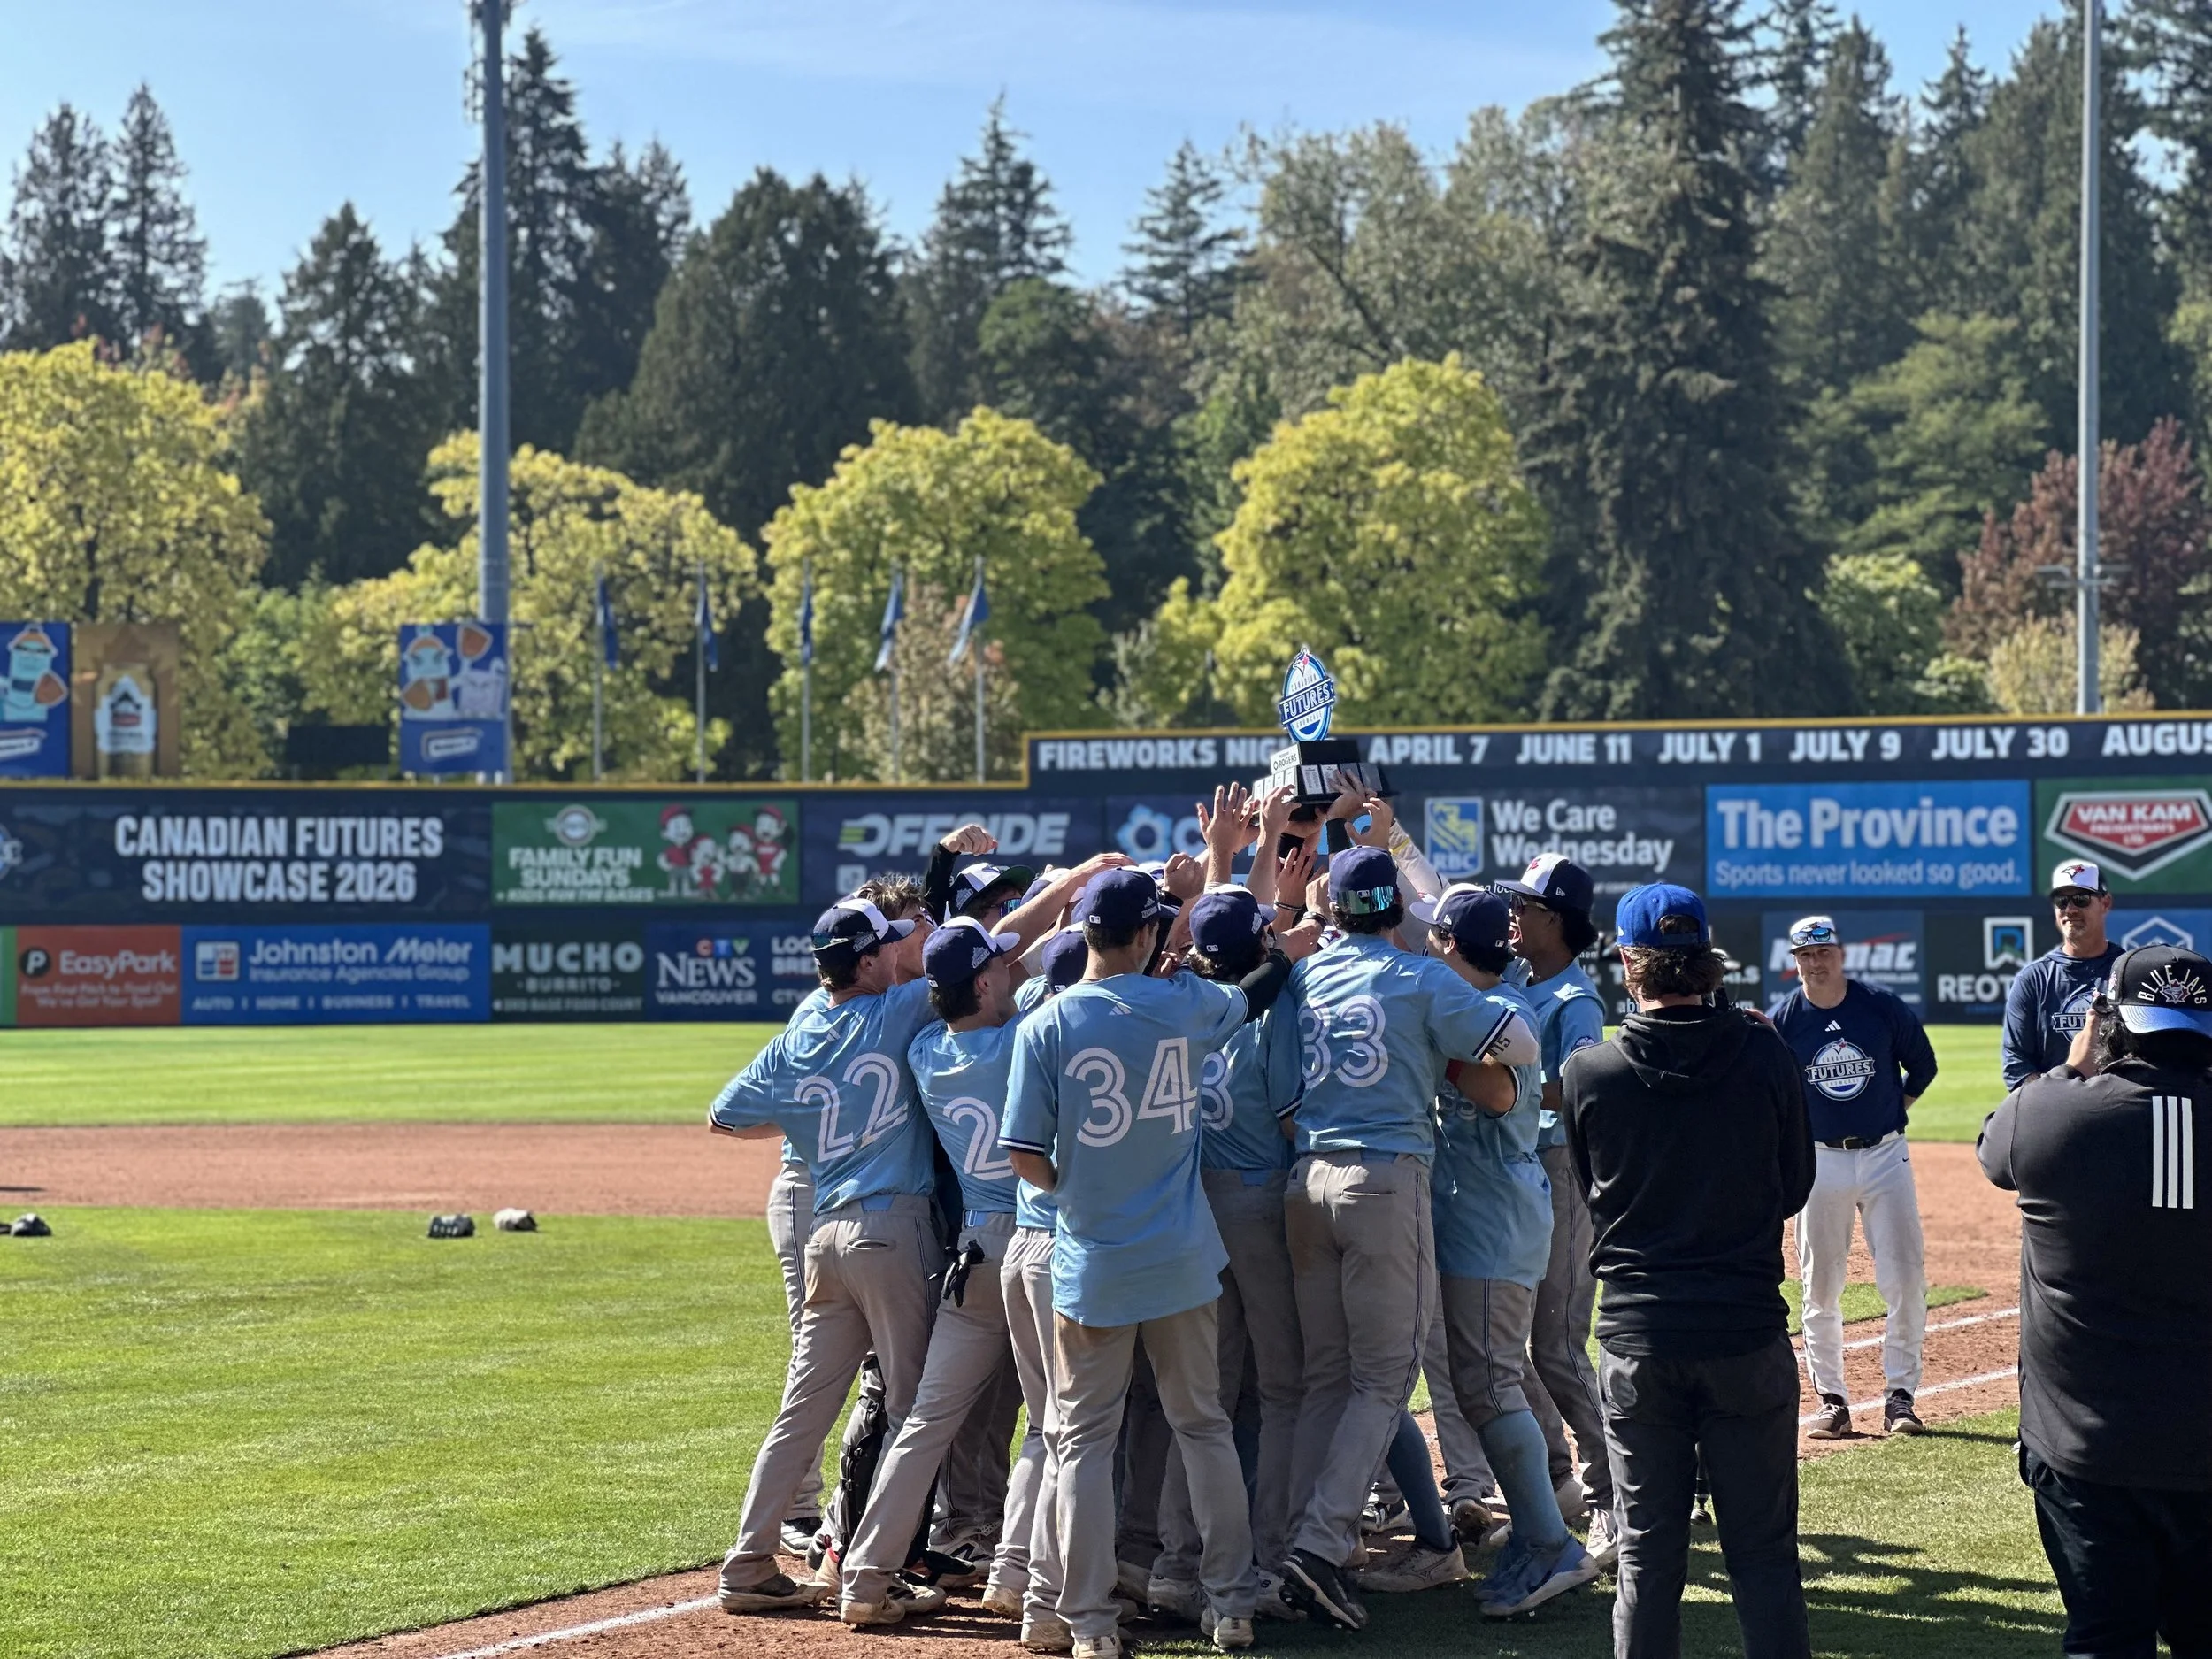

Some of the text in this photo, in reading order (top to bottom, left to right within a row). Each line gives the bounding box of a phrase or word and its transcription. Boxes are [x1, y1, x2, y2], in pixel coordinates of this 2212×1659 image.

[1283, 683, 1330, 720] FUTURES
[1038, 737, 1288, 770] FIREWORKS NIG
[1368, 735, 1490, 764] APRIL 7
[1516, 733, 1631, 764] JUNE 11
[1658, 733, 1761, 763] JULY 1
[1789, 731, 1901, 762] JULY 9
[1932, 727, 2069, 760] JULY 30
[1279, 753, 1297, 767] ROGERS
[1491, 800, 1617, 833] We Care
[1717, 797, 2018, 849] The Province
[2077, 803, 2192, 823] VAN KAM
[115, 816, 443, 857] CANADIAN FUTURES
[509, 846, 642, 869] FAMILY FUN
[1431, 851, 1476, 872] RBC
[142, 860, 417, 902] SHOWCASE 2026
[521, 867, 631, 887] SUNDAYS
[1716, 858, 2021, 890] Sports never looked so good.
[248, 939, 378, 964] Johnston
[492, 941, 644, 973] MUCHO
[696, 939, 749, 956] CTV
[772, 936, 811, 955] LOC
[59, 949, 177, 979] EasyPark
[415, 964, 470, 983] Group
[655, 989, 757, 1005] VANCOUVER
[1938, 974, 2015, 1002] REOT
[2137, 964, 2208, 1004] BLUE JAYS
[192, 996, 234, 1010] AUTO
[1810, 1062, 1871, 1080] FUTURES
[794, 1052, 908, 1163] 22
[1064, 1037, 1197, 1148] 34
